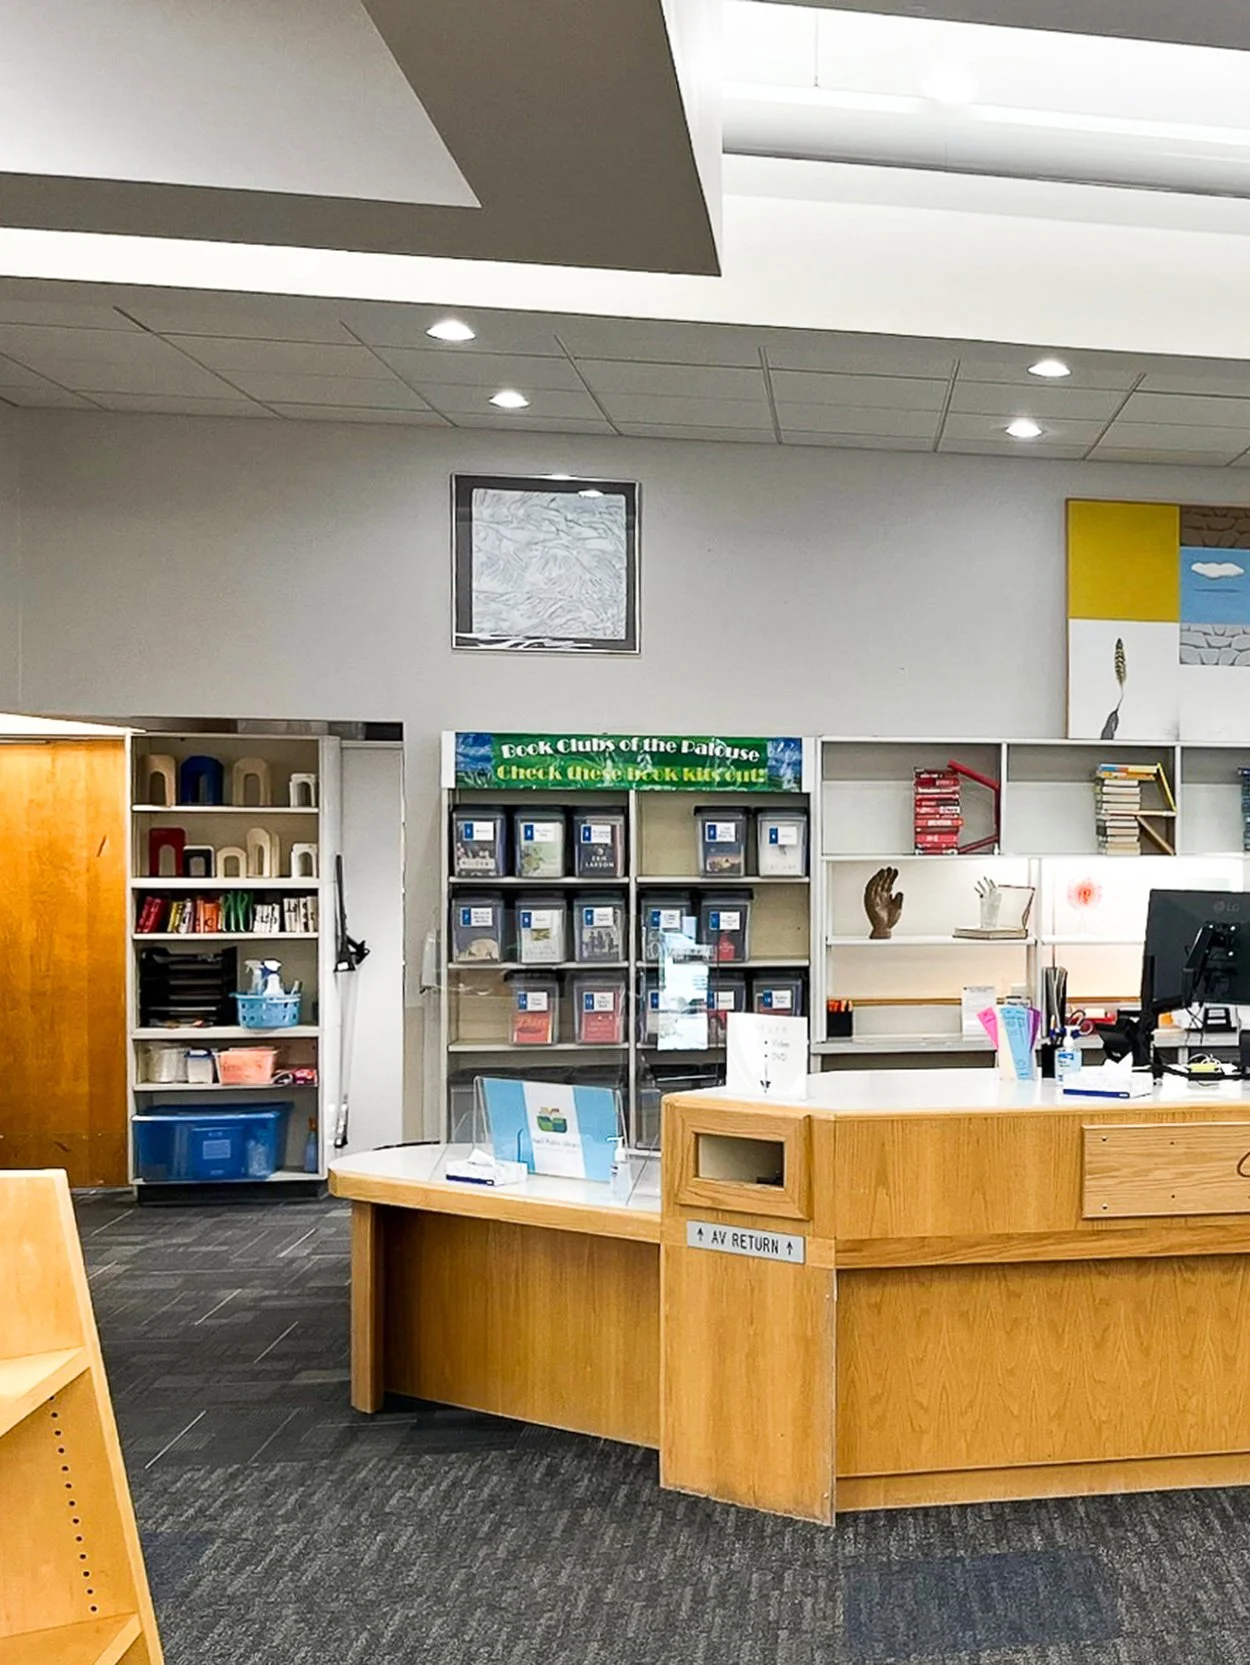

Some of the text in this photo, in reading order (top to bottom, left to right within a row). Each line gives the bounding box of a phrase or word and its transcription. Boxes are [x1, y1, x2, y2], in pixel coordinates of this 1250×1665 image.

[501, 737, 760, 762] Book Clubs of the Palouse
[497, 765, 562, 781] Check
[567, 765, 622, 781] these
[711, 1229, 779, 1254] AV RETURN
